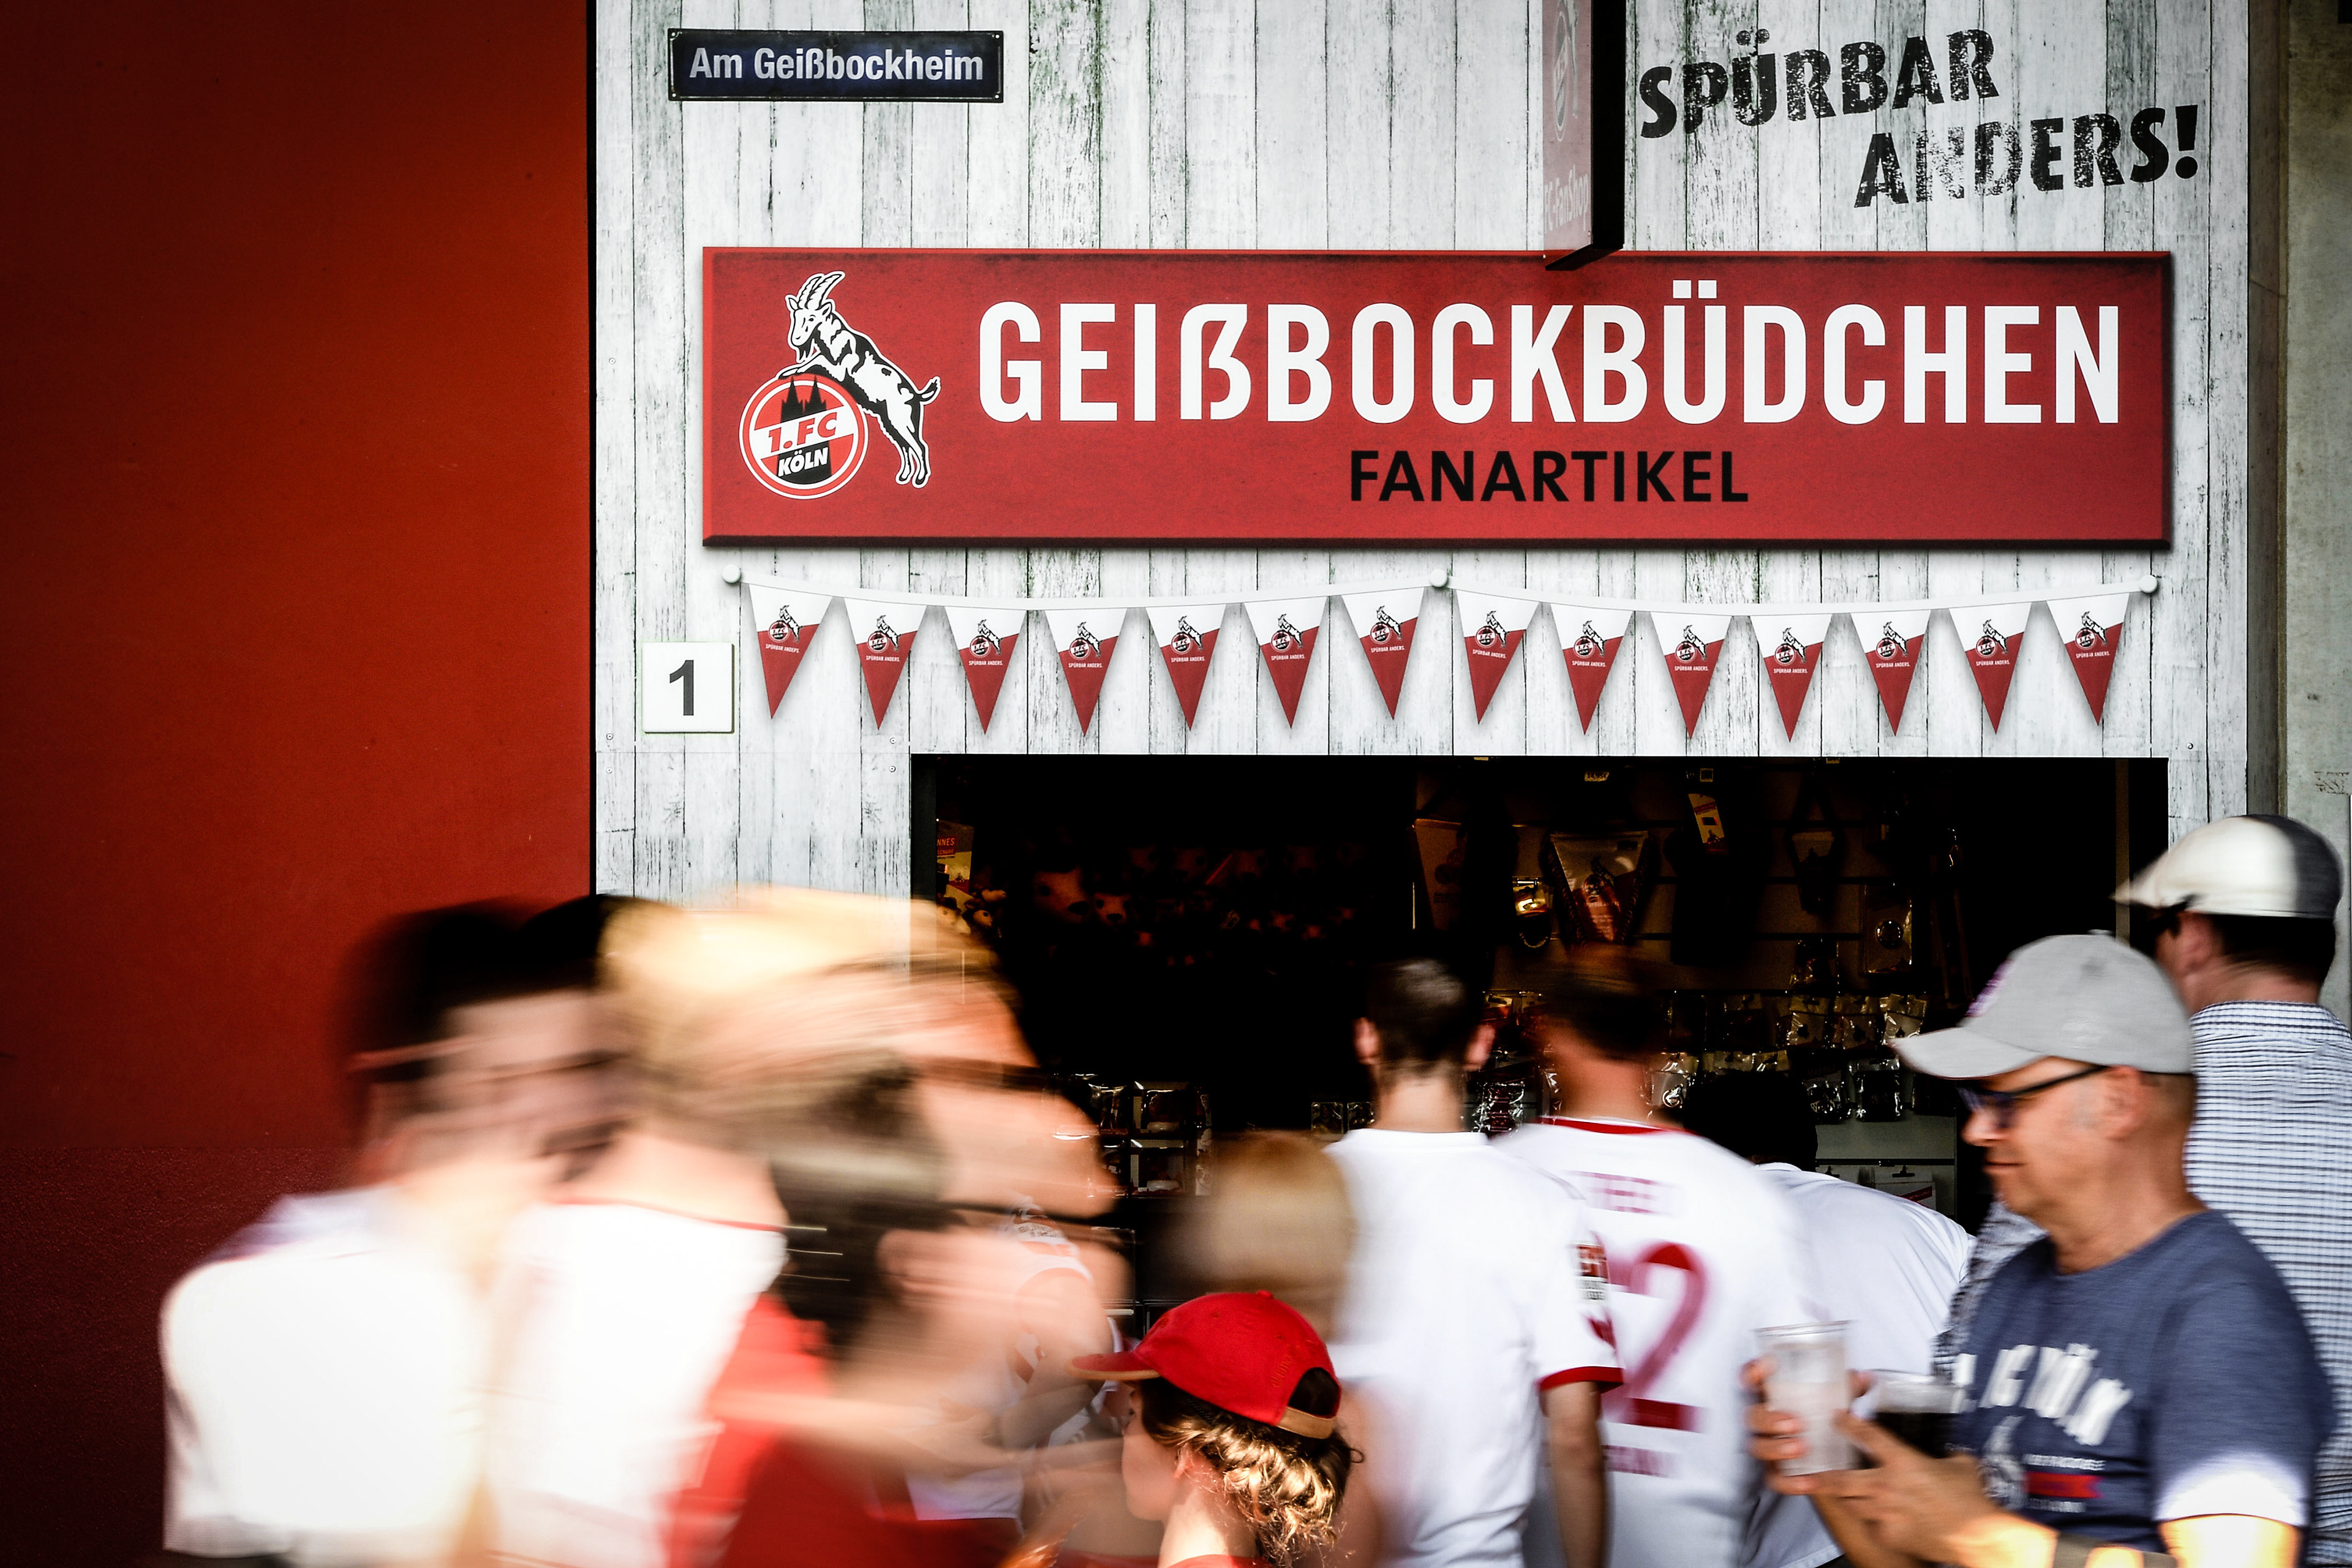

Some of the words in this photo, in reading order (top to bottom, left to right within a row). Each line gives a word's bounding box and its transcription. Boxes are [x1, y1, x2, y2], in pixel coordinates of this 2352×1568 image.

[689, 47, 742, 79] Am
[754, 48, 983, 81] Geißbockheim
[1639, 28, 1999, 138] SPÜRBAR
[1853, 104, 2199, 208] ANDERS!
[1544, 164, 1589, 234] FC-FanShop
[768, 412, 837, 453] 1.FC
[778, 447, 829, 477] KÖLN
[1351, 450, 1749, 502] FANARTIKEL
[669, 659, 695, 717] 1
